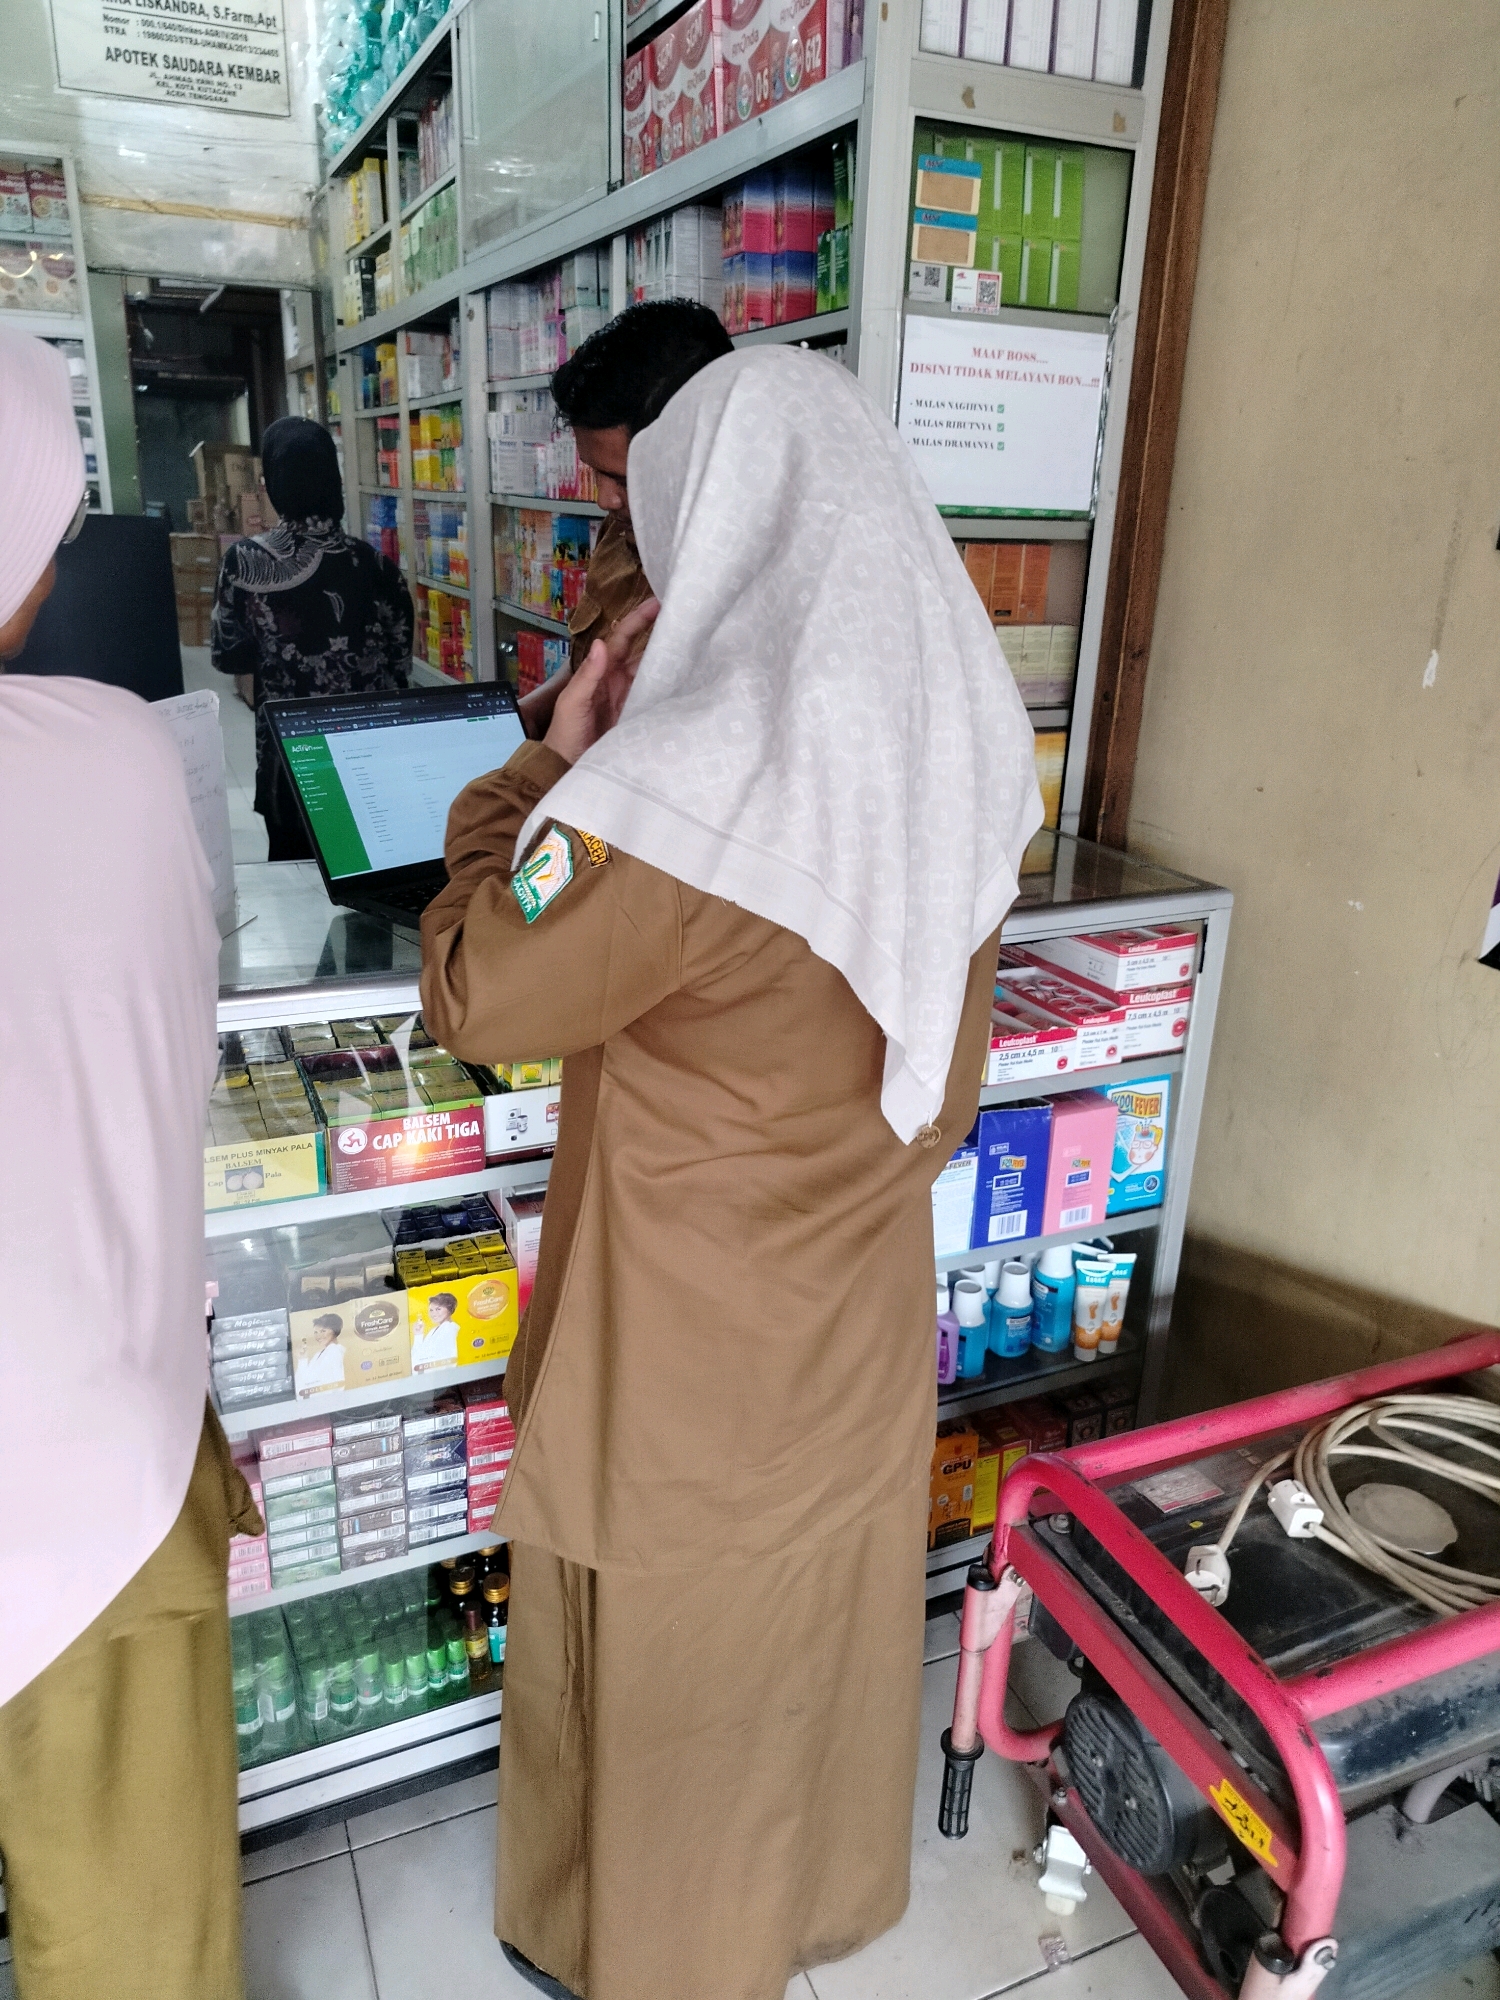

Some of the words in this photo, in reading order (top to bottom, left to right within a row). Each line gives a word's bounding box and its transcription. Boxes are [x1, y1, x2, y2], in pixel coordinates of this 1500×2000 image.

[103, 13, 130, 25] Nomor
[104, 26, 127, 36] STRA
[105, 46, 159, 69] APOTEK
[163, 54, 224, 77] SAUDARA
[227, 63, 281, 85] KEMBAR
[971, 347, 1005, 359] MAAF
[910, 362, 951, 375] DISINI
[954, 365, 992, 380] TIDAK
[995, 369, 1055, 384] MELAYANI
[915, 399, 945, 409] MALAS
[948, 402, 994, 413] NAGIHNYA
[914, 418, 944, 428] MALAS
[945, 420, 992, 431] RIBUTNYA
[912, 437, 942, 447] MALAS
[945, 439, 994, 450] DRAMANYA
[1128, 943, 1159, 953] Leukoplast
[1130, 989, 1177, 1004] Leukoplast
[1082, 1015, 1110, 1025] Leukoplast
[1128, 1012, 1137, 1021] 7,5
[1138, 1012, 1147, 1020] cm
[1153, 1010, 1162, 1018] 4,5
[999, 1034, 1037, 1048] Leukoplast
[999, 1052, 1009, 1061] 2,5
[1027, 1048, 1037, 1057] 4,5
[1134, 1096, 1160, 1115] FEVER
[402, 1112, 451, 1131] BALSEM
[373, 1132, 403, 1150] CAP
[406, 1125, 443, 1145] KAKI
[445, 1120, 480, 1139] TIGA
[231, 1150, 254, 1160] PLUS
[256, 1145, 288, 1156] MINYAK
[290, 1142, 313, 1152] PALA
[225, 1158, 262, 1169] BALSEM
[264, 1171, 282, 1179] Pala
[207, 1180, 224, 1188] Cap
[234, 1319, 260, 1328] Magic
[361, 1316, 394, 1328] FreshCare
[304, 1386, 323, 1395] ROLL
[942, 1459, 973, 1475] GPU
